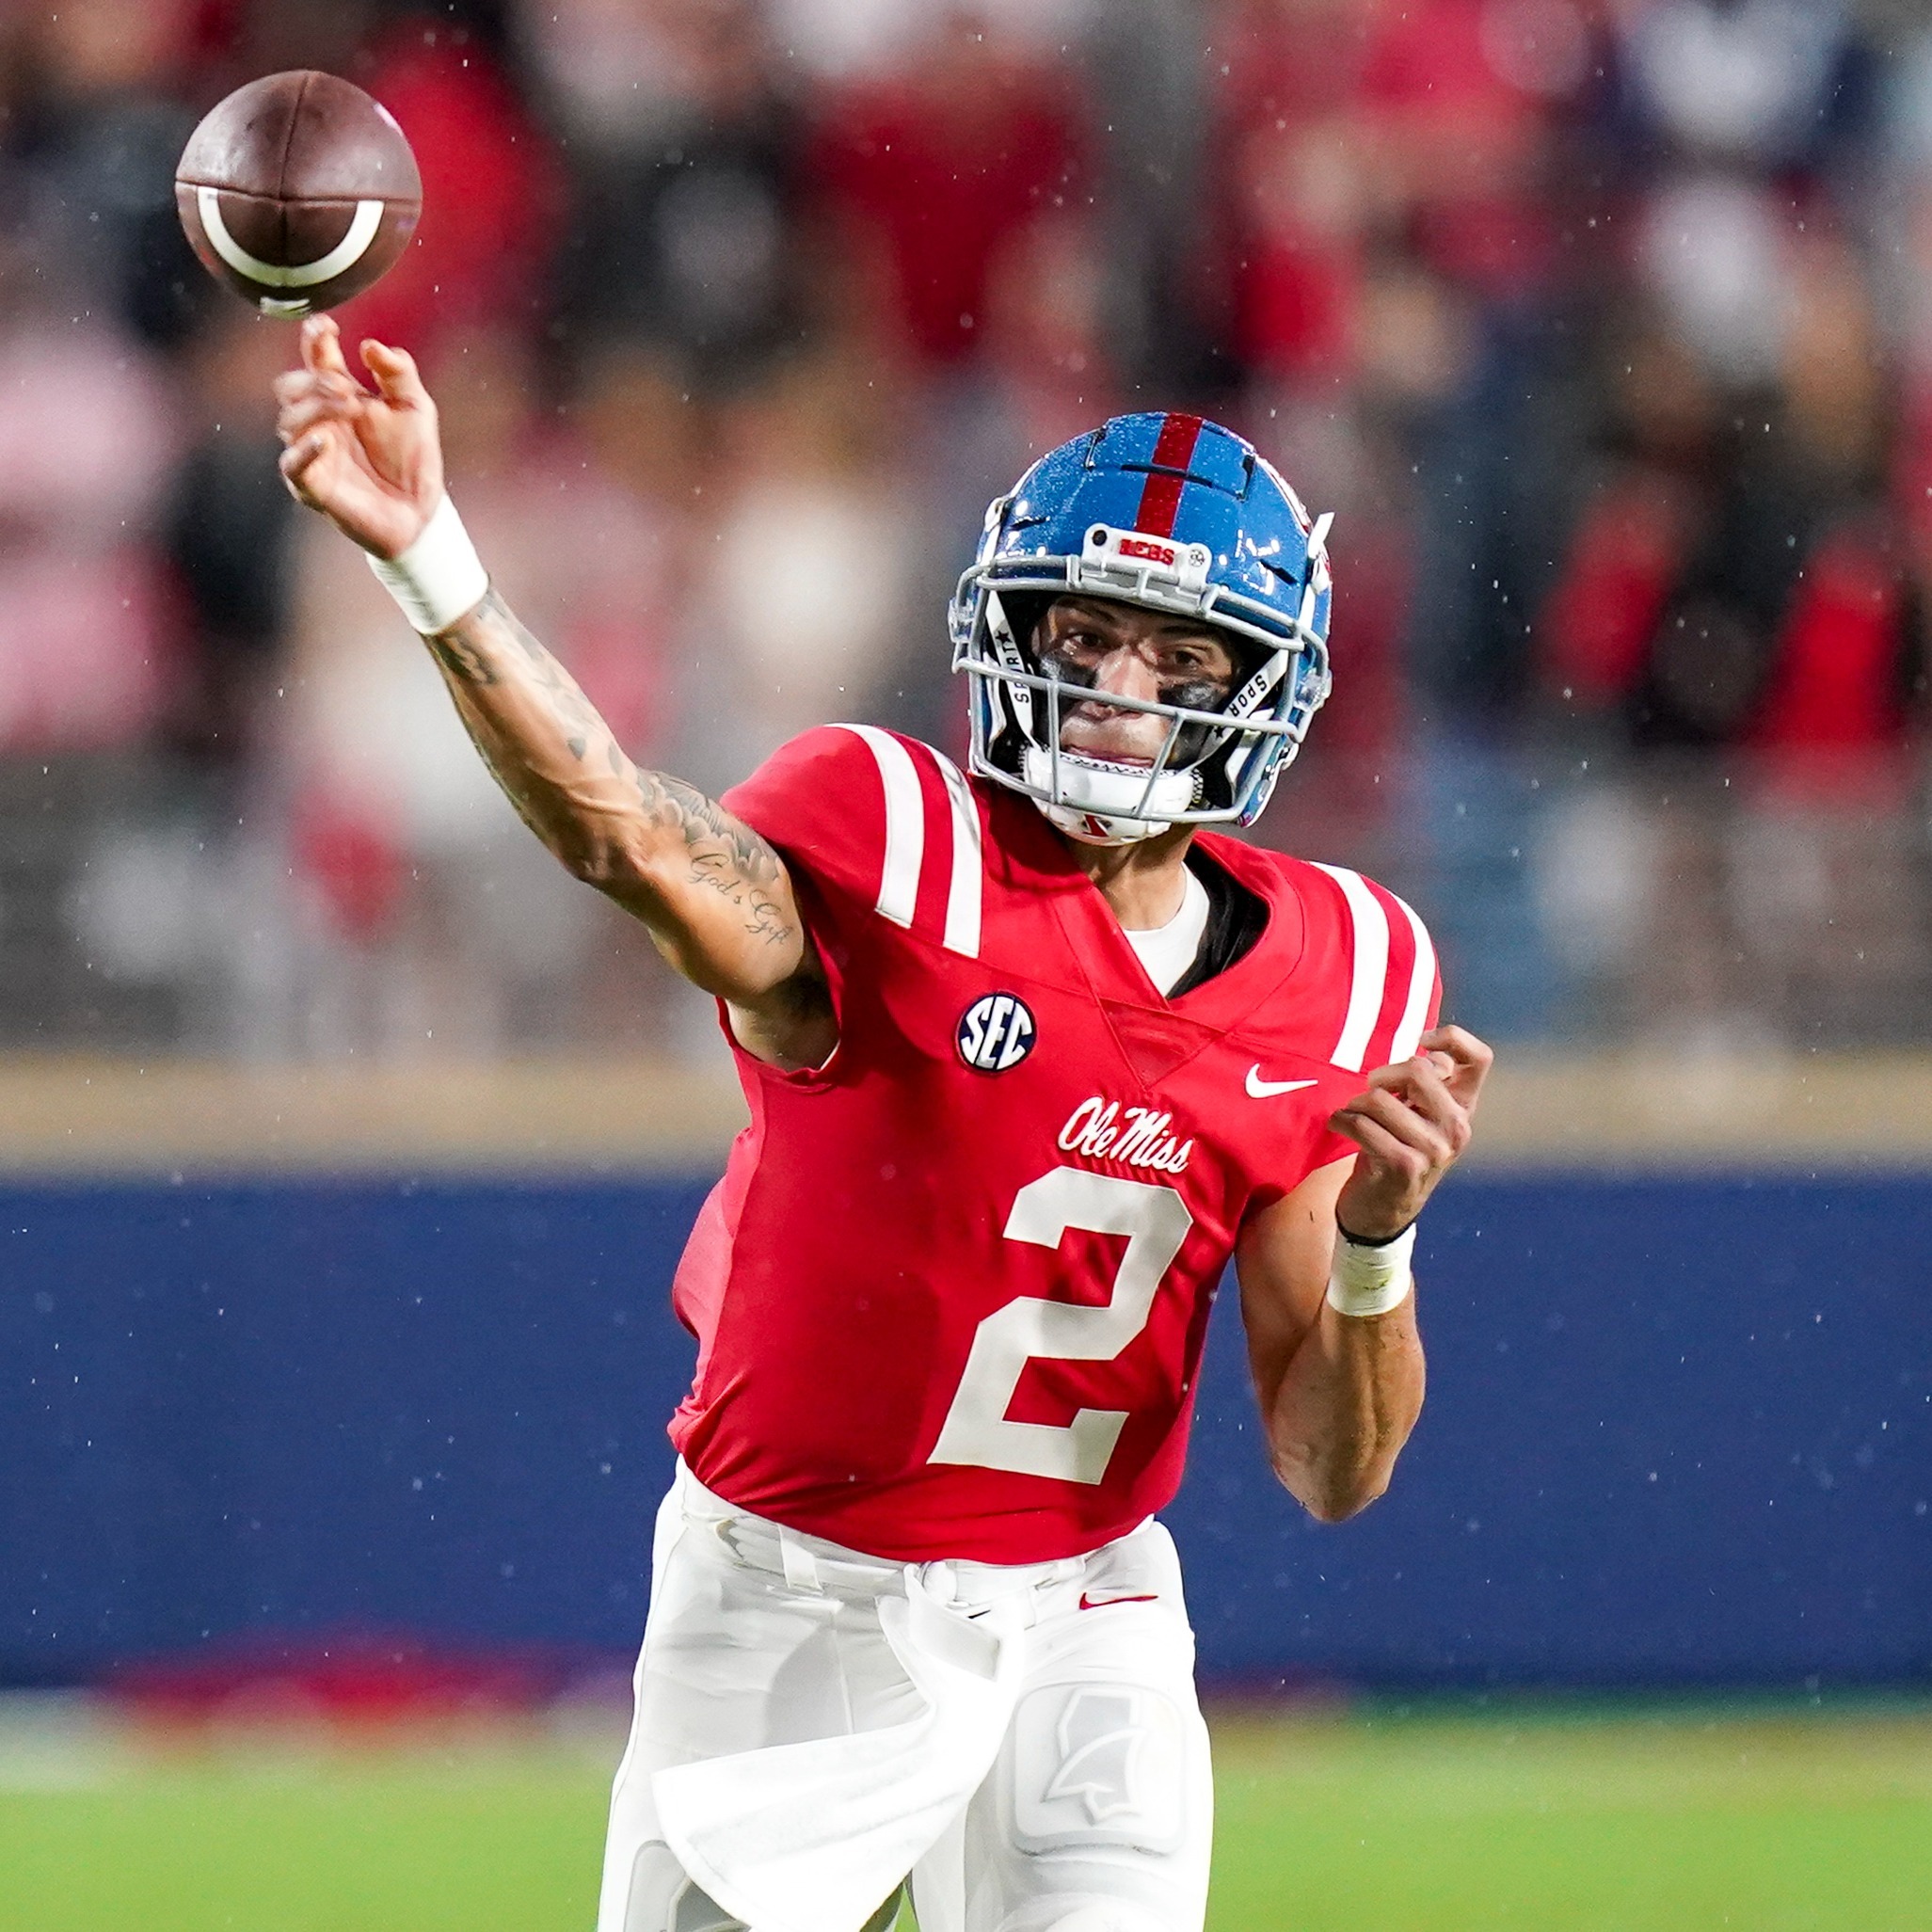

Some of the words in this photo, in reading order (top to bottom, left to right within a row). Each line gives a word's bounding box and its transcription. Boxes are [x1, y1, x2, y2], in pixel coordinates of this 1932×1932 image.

[959, 995, 1033, 1071] SEC
[1058, 1095, 1121, 1158] Ole
[1109, 1107, 1194, 1174] Miss
[926, 1165, 1194, 1486] 2
